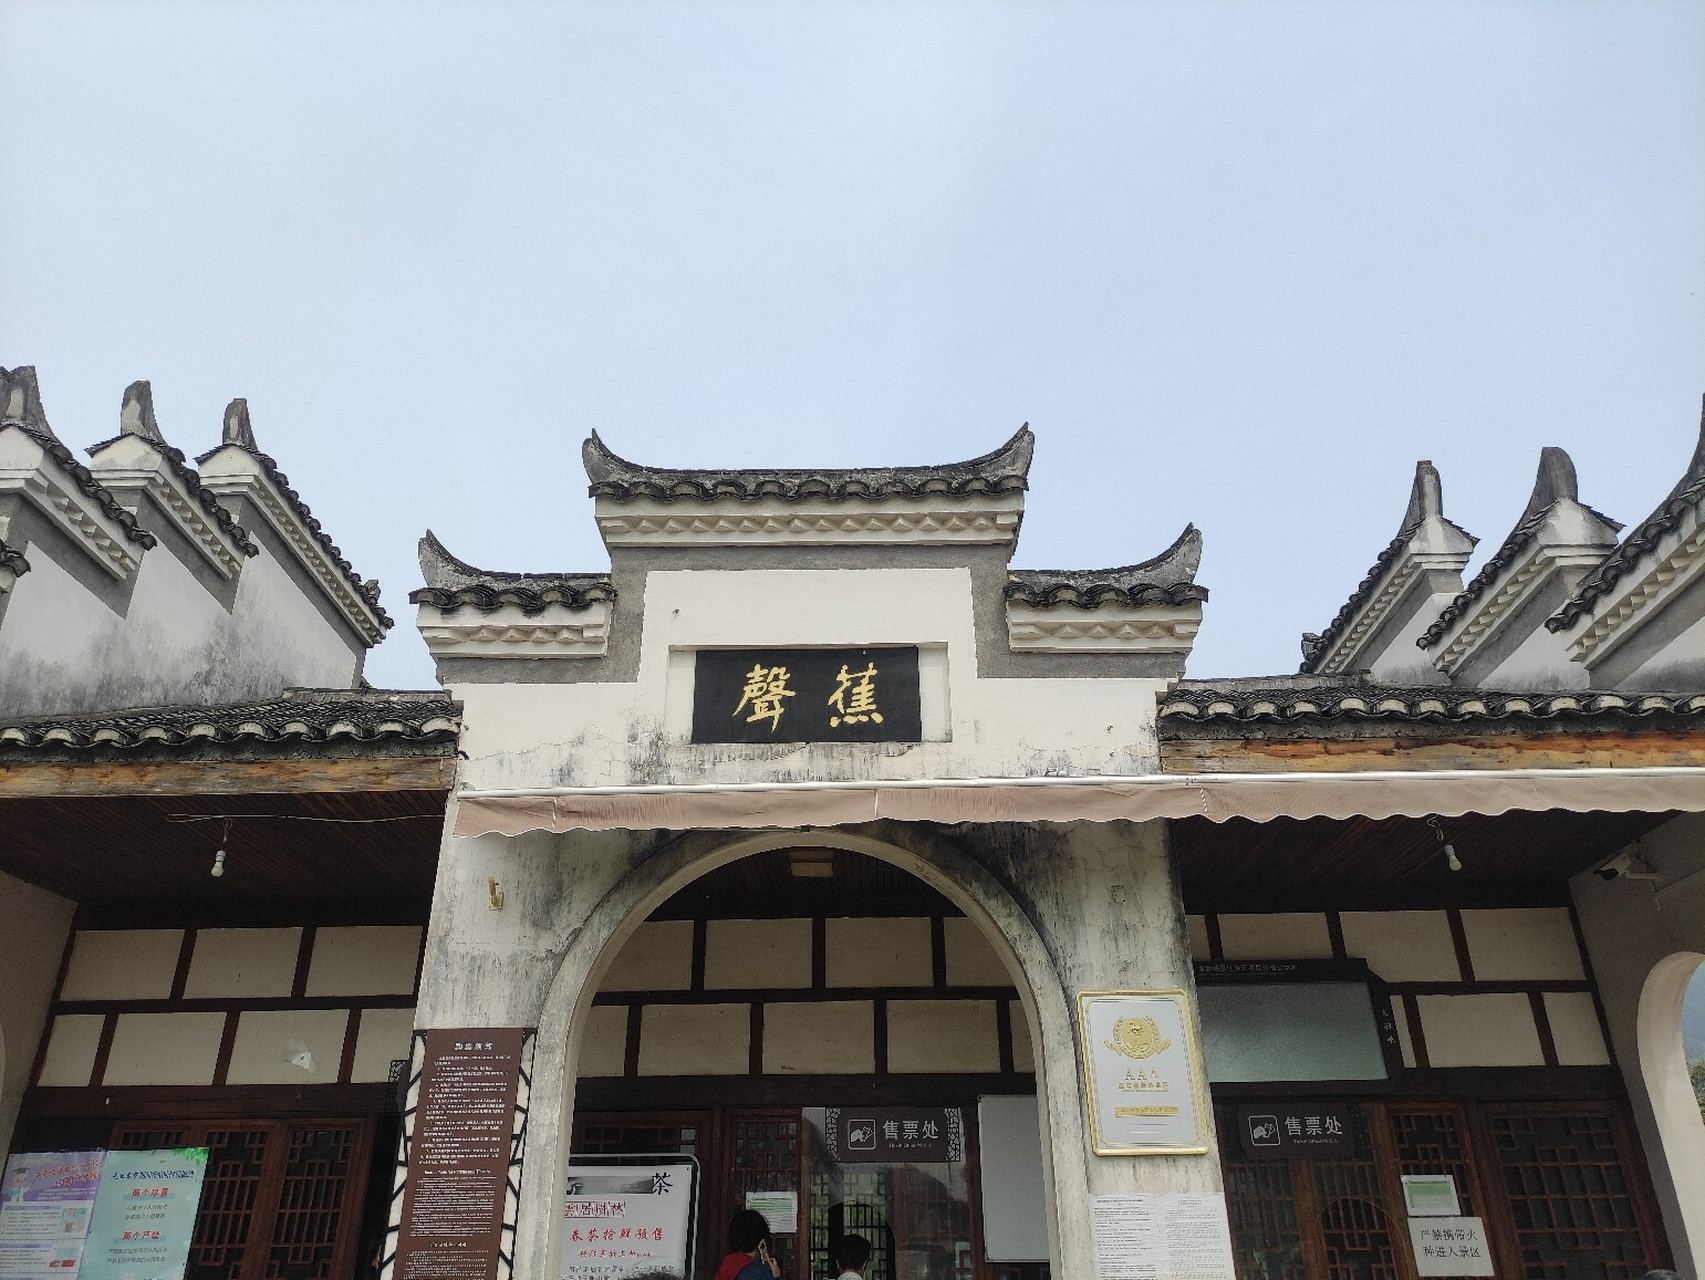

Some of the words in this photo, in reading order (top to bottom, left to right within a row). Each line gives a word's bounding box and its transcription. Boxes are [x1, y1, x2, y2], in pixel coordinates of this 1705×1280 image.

[882, 1120, 939, 1140] 售票处
[1284, 1116, 1343, 1136] 售票处
[649, 1172, 674, 1196] 茶
[1420, 1228, 1478, 1241] 严禁携带火
[1423, 1245, 1482, 1258] 种进入景区
